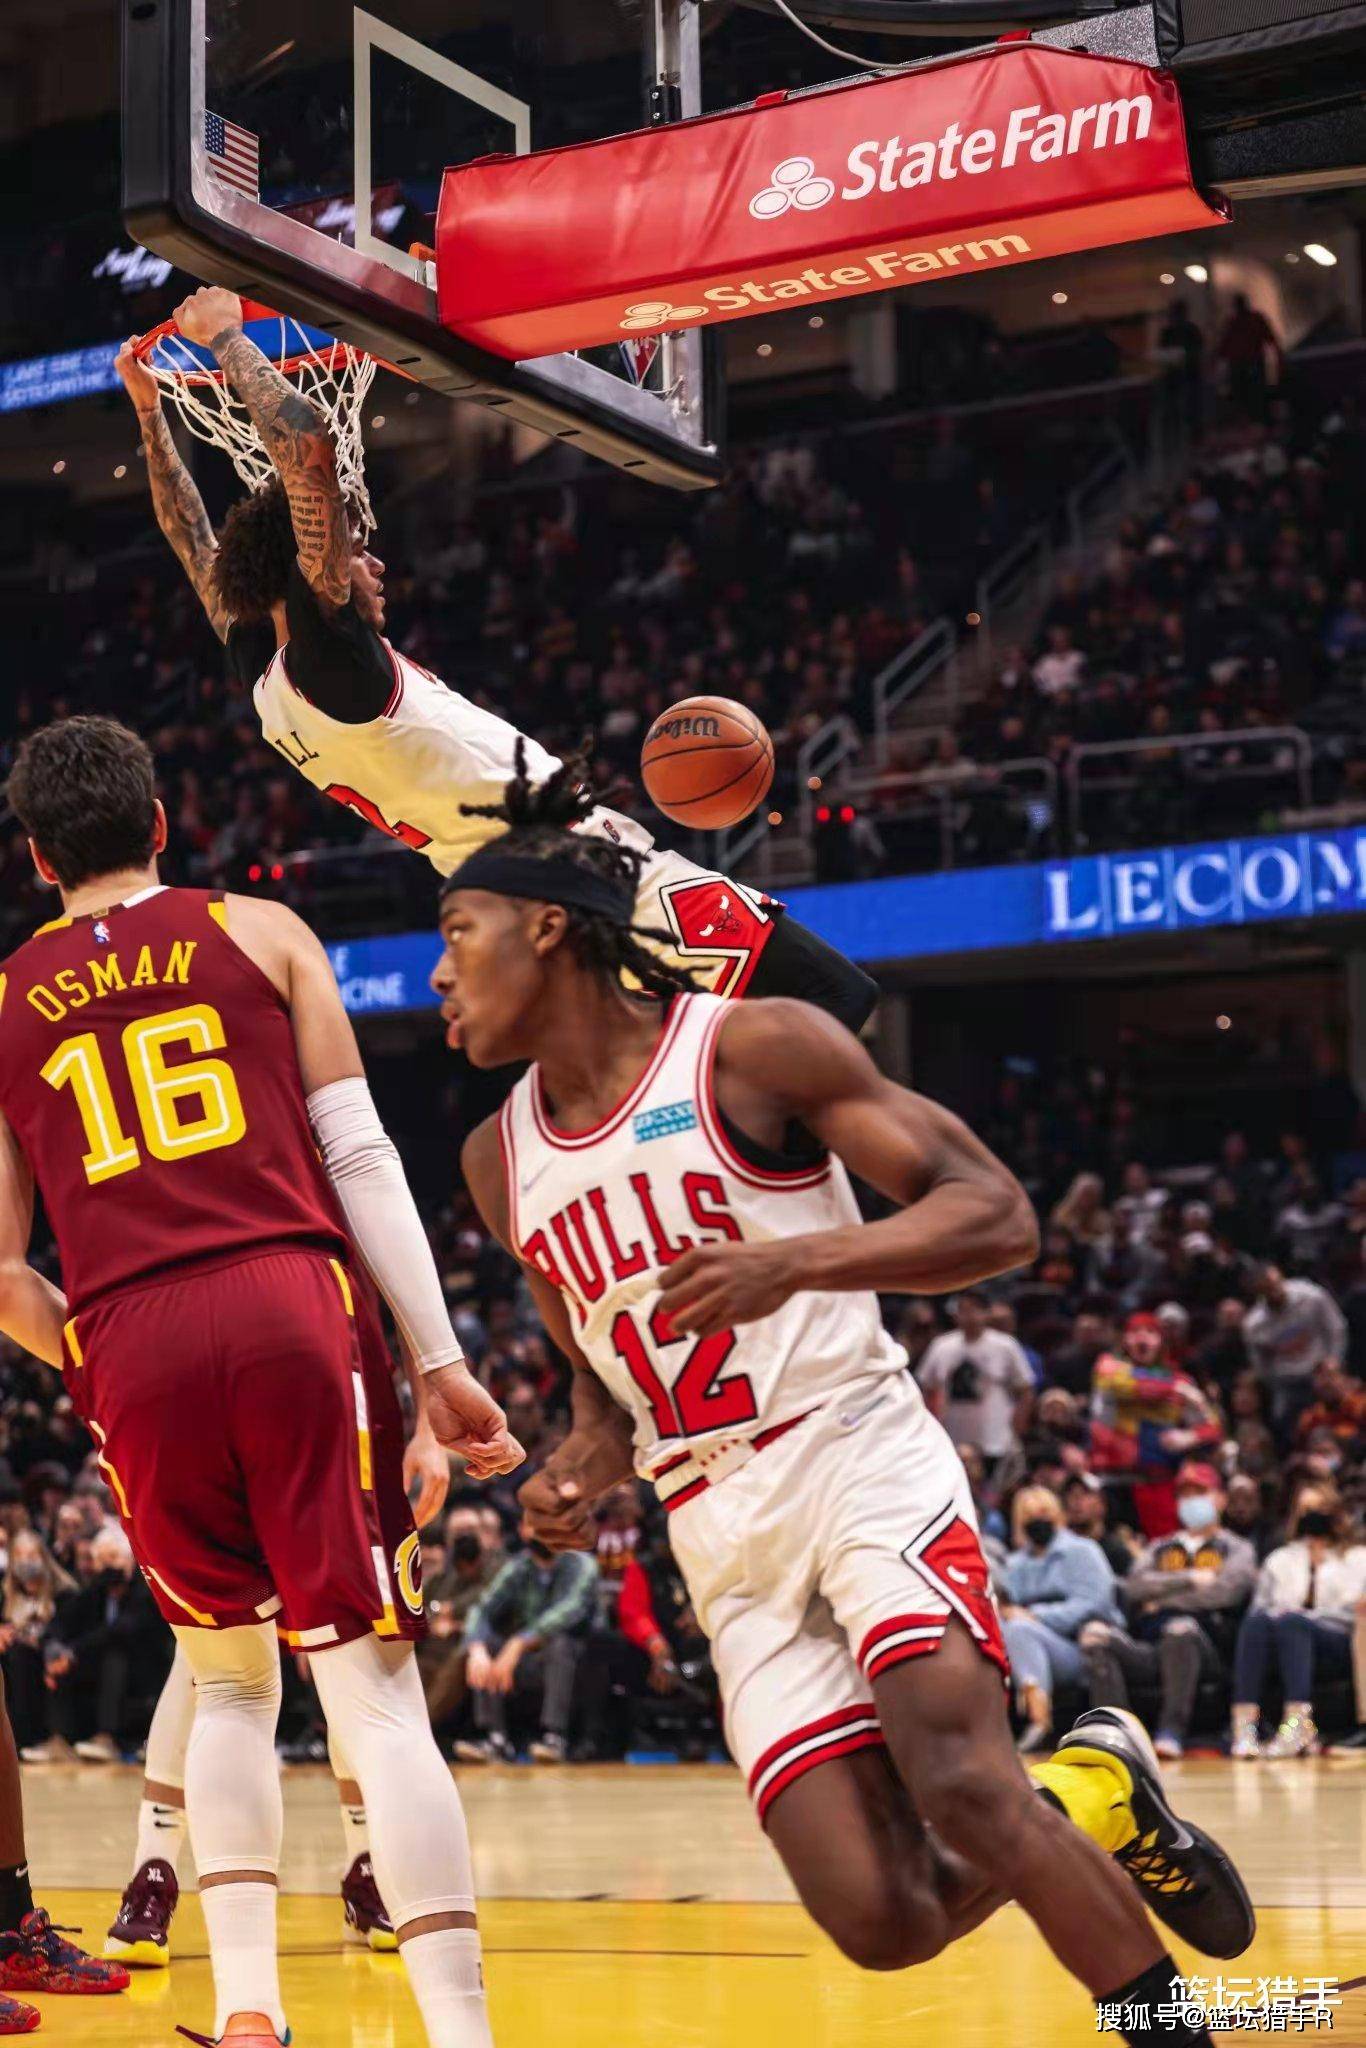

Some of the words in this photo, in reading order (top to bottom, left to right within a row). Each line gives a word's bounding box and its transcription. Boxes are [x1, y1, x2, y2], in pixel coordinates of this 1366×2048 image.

[841, 121, 997, 201] State
[1000, 93, 1153, 169] Farm
[703, 263, 873, 312] State
[865, 232, 1032, 280] Farm
[26, 940, 198, 1022] OSMAN
[38, 1003, 248, 1186] 16
[610, 1303, 758, 1440] 12
